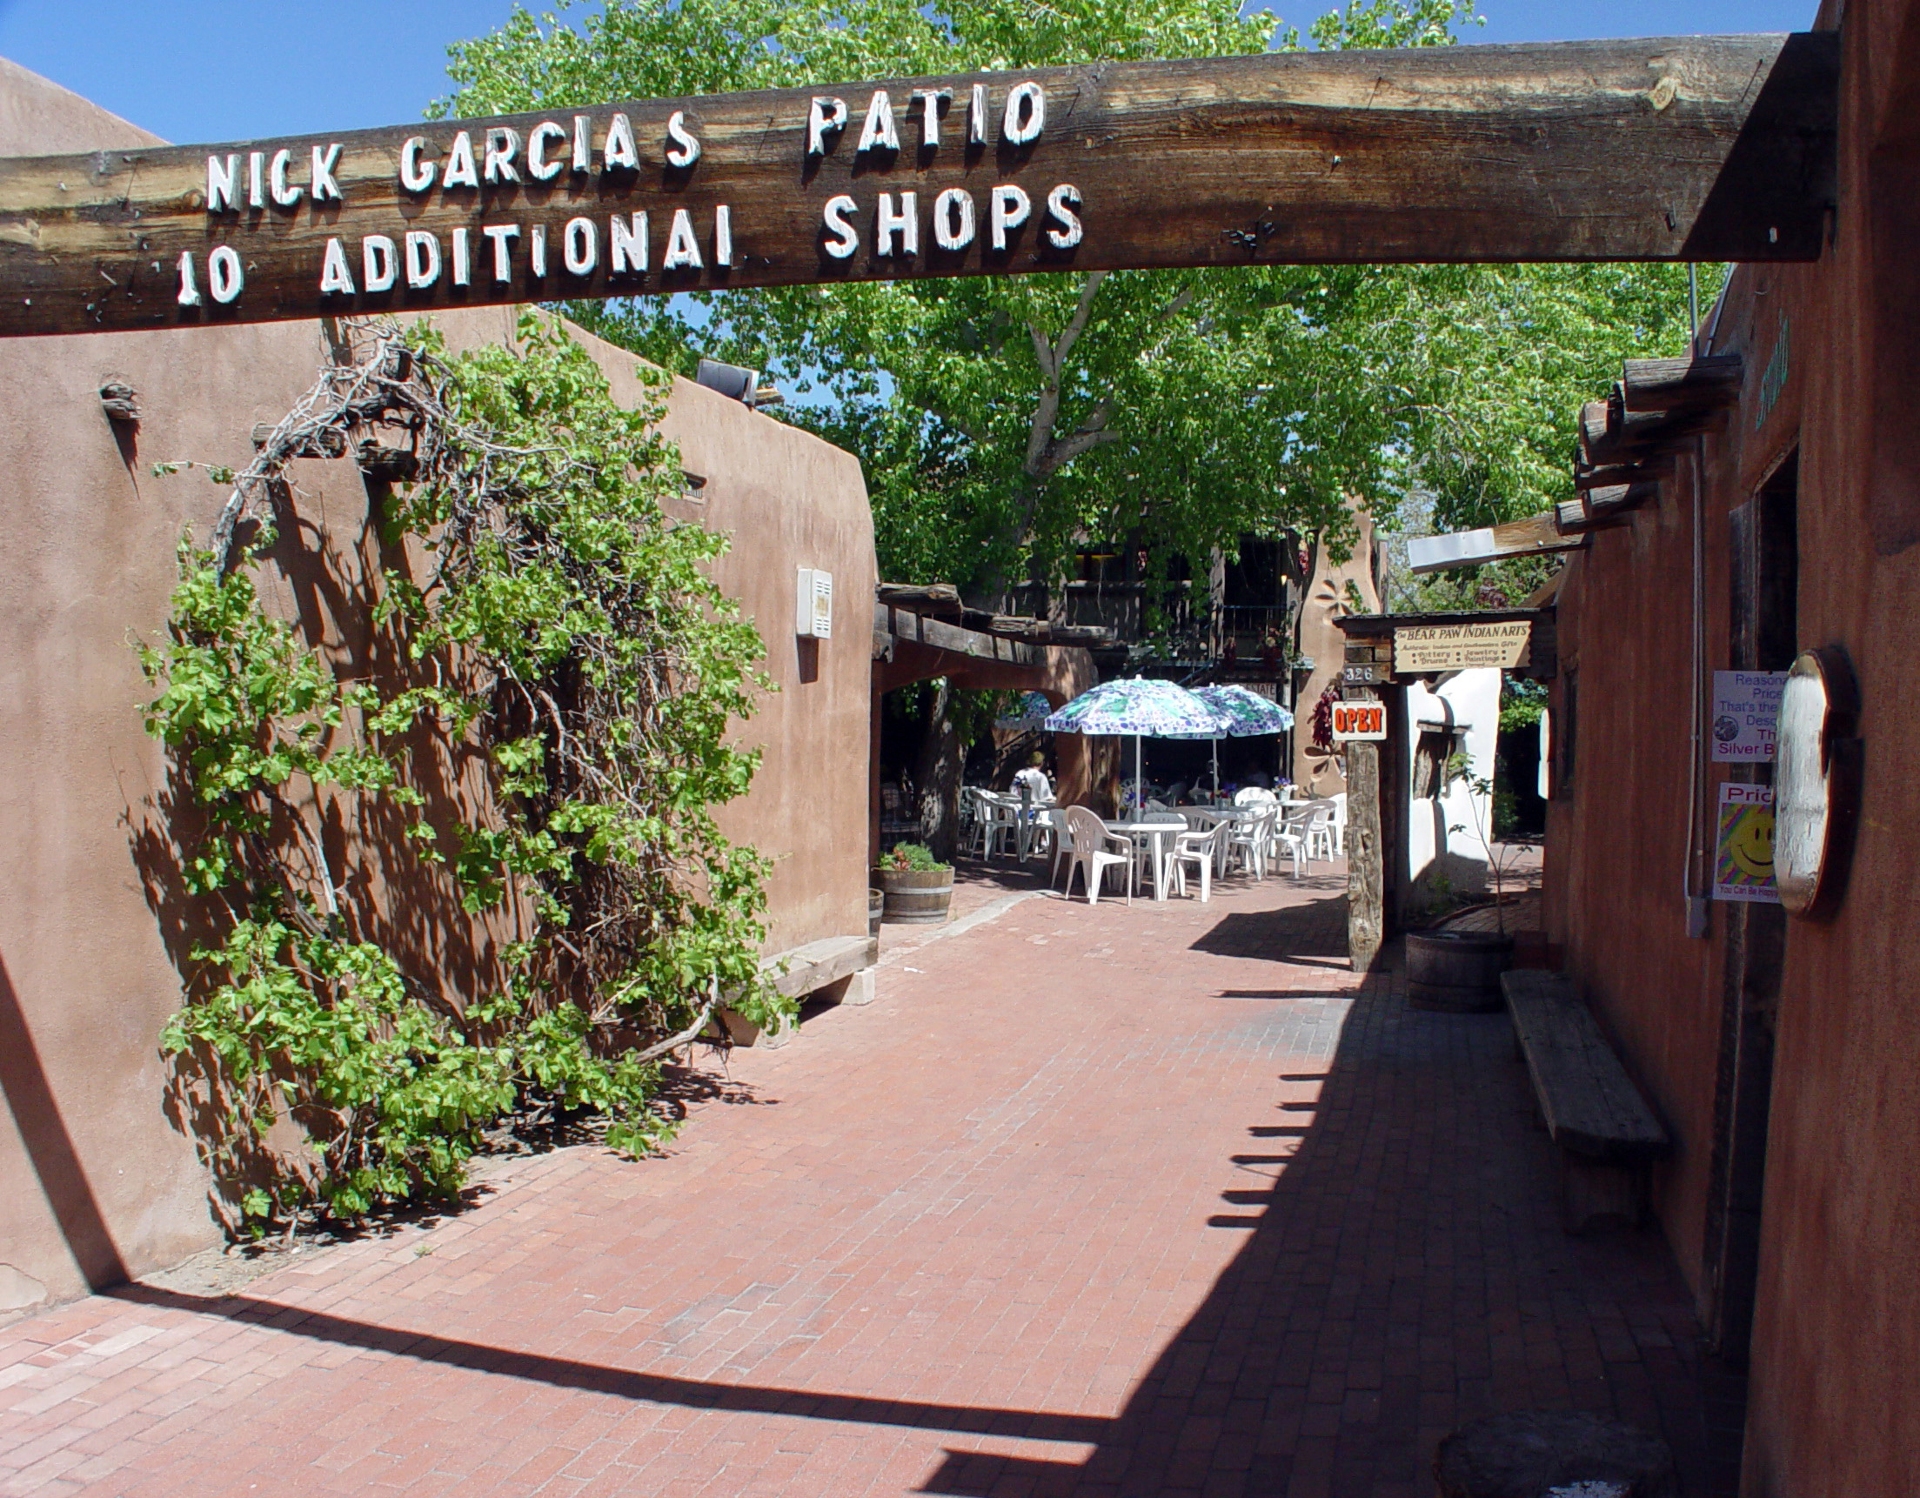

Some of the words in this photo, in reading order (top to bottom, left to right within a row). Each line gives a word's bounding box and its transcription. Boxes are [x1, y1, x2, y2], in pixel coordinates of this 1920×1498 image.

[207, 142, 344, 214] NICK
[808, 81, 1047, 156] PATIO
[177, 245, 244, 307] 10
[823, 183, 1083, 259] SHOPS
[1407, 629, 1436, 641] BEAR
[1439, 627, 1462, 640] PAW
[1463, 626, 1500, 639] INDIAN
[1500, 625, 1527, 637] ARTS
[1501, 640, 1518, 648] Gifts
[1417, 651, 1451, 660] Pottery
[1465, 649, 1498, 657] Jewelry
[1464, 656, 1500, 664] Paintings
[1346, 667, 1373, 681] 326
[1720, 701, 1755, 712] That's
[1758, 701, 1778, 713] the
[1335, 707, 1382, 734] OPEN
[1719, 742, 1760, 754] Silver
[1764, 743, 1775, 755] B
[1720, 886, 1732, 894] You
[1734, 885, 1747, 895] Can
[1748, 886, 1757, 895] Be
